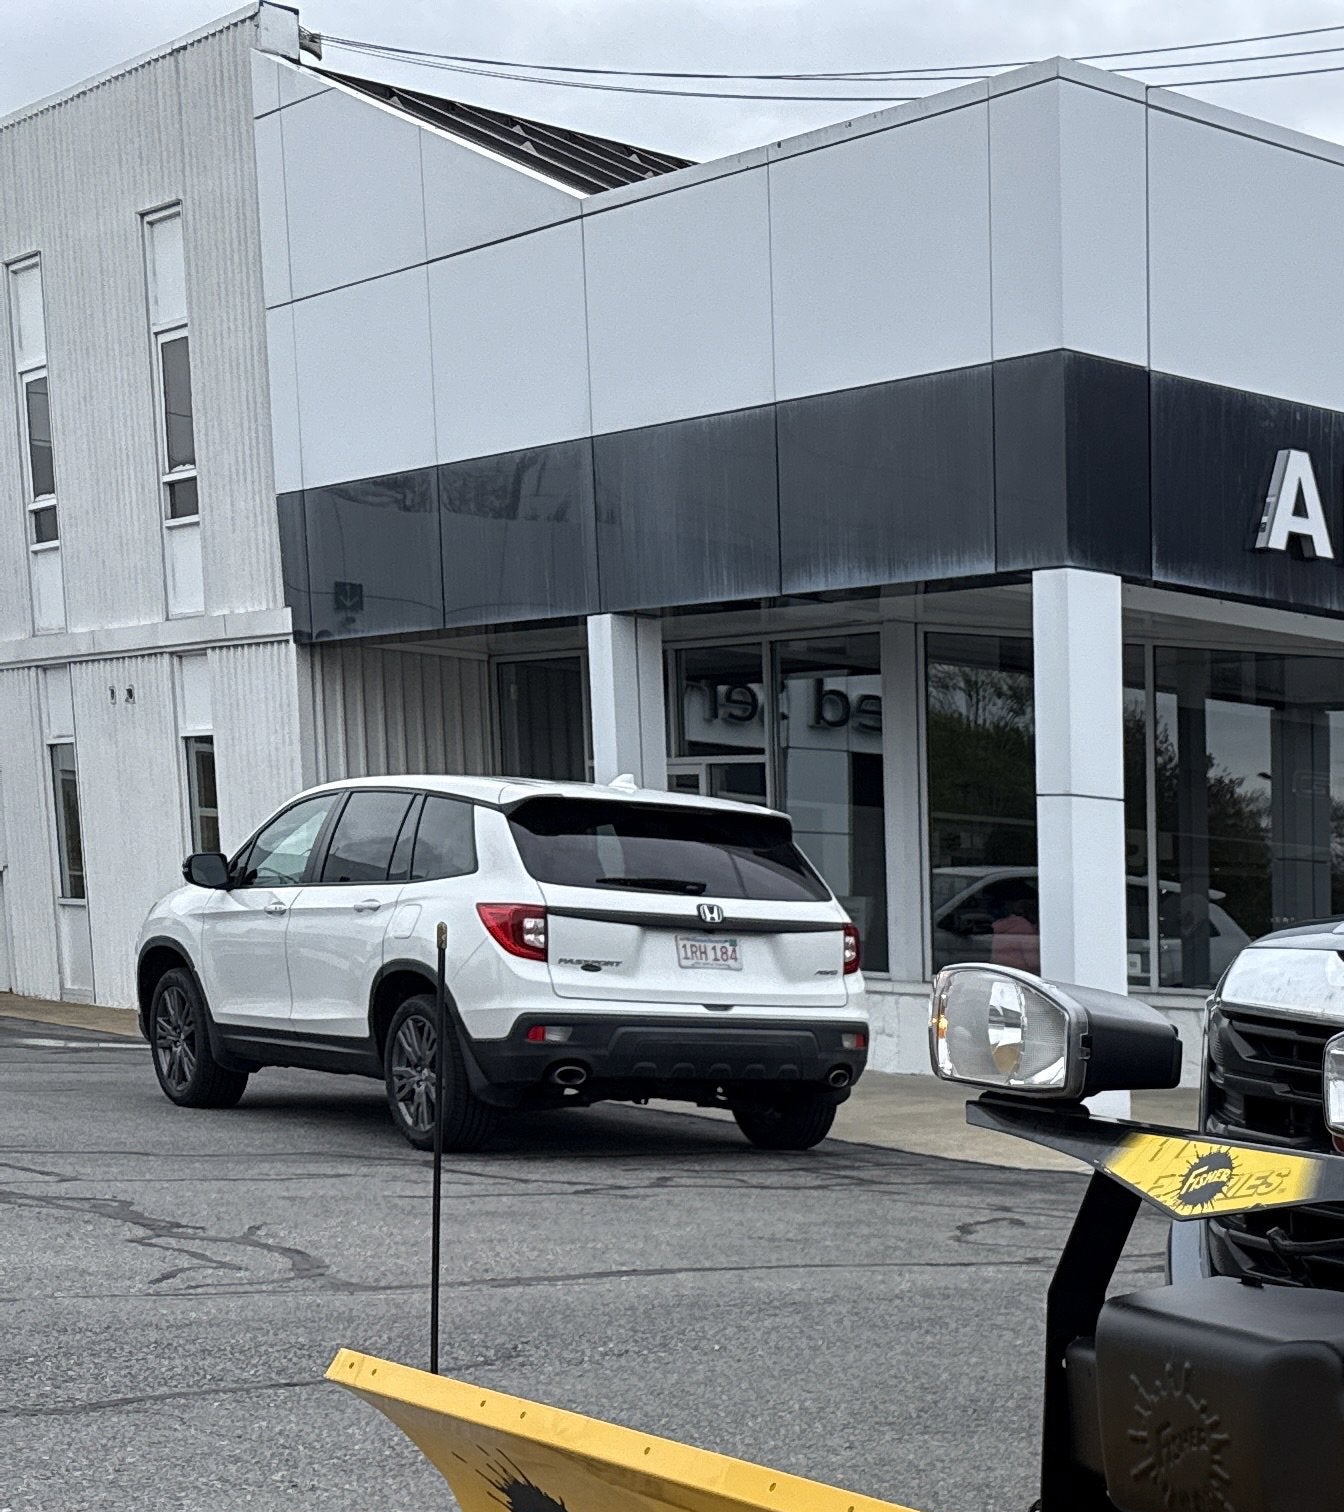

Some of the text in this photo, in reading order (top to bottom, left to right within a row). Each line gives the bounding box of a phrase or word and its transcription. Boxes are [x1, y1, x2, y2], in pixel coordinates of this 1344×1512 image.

[681, 943, 739, 963] 1RH 184
[1180, 1165, 1232, 1195] FISHER
